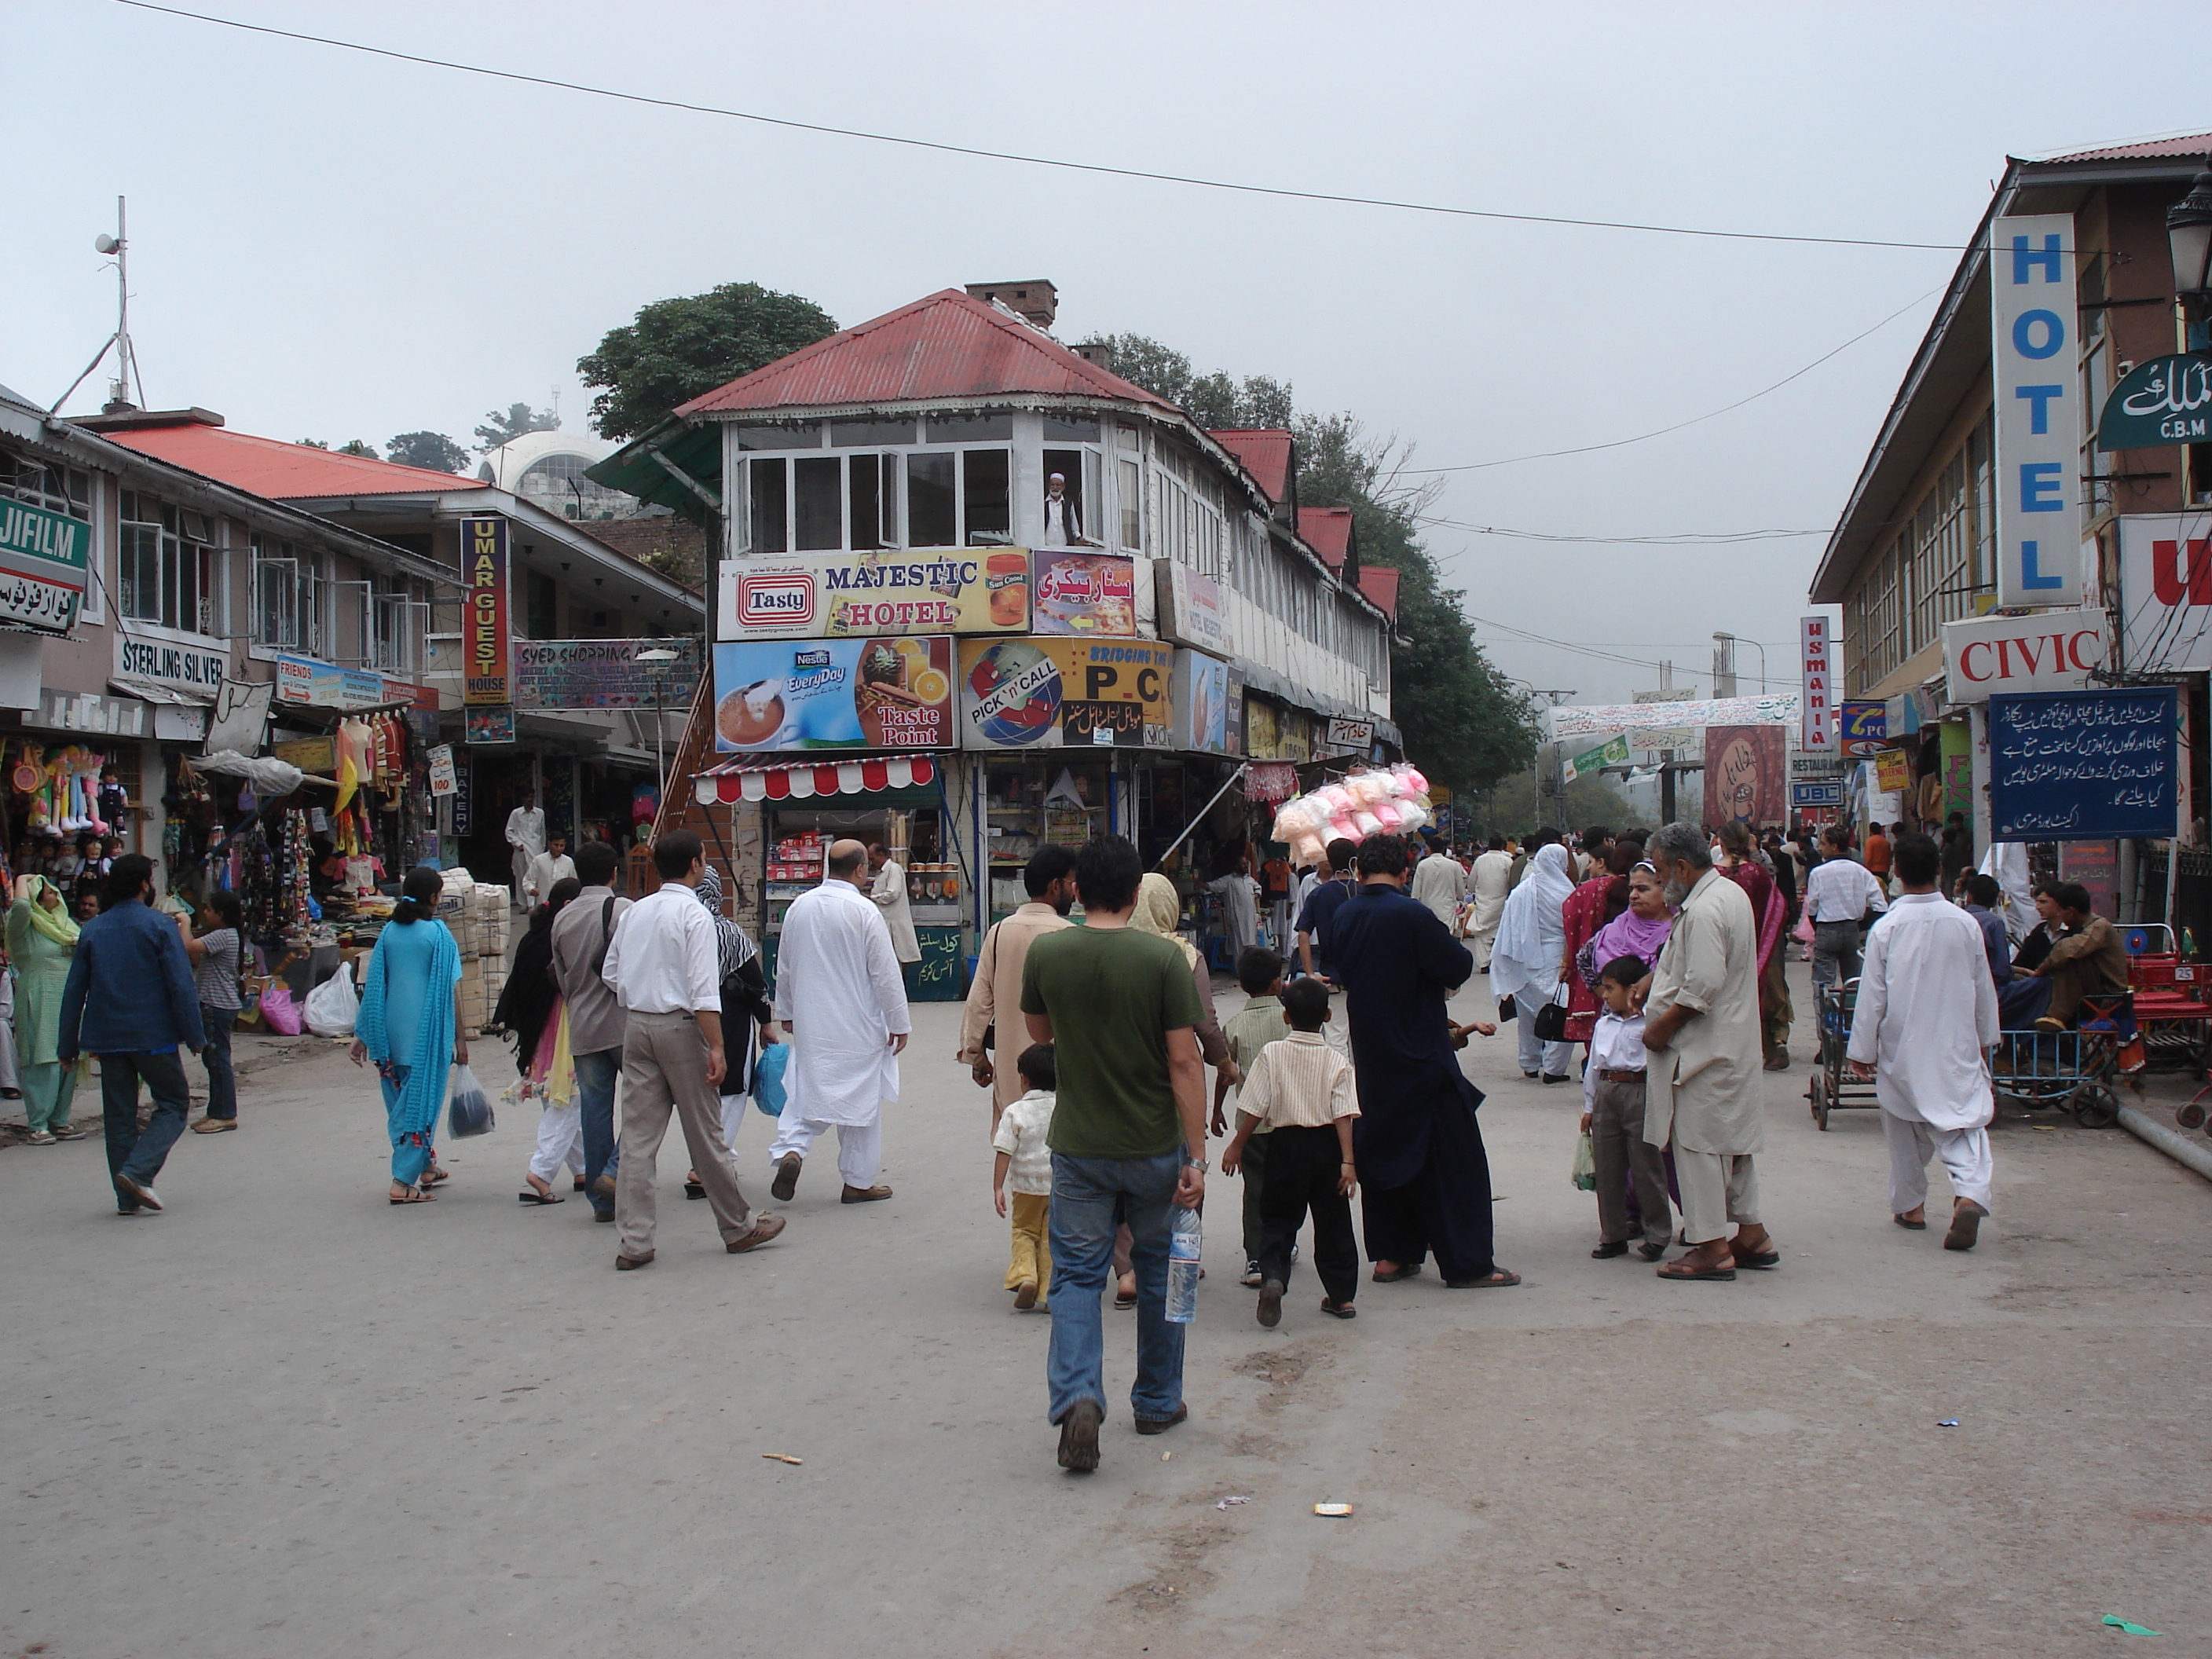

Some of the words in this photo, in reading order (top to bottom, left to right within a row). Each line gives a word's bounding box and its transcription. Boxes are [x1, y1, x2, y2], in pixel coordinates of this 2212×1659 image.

[2012, 233, 2065, 590] HOTEL
[474, 522, 495, 588] UMAR
[826, 561, 979, 589] MAJESTIC
[989, 580, 1004, 589] Sun
[752, 591, 804, 610] Tasty
[849, 601, 954, 626] HOTEL
[475, 593, 496, 676] GUEST
[123, 641, 181, 679] STERLING
[185, 653, 222, 686] SILVER
[522, 648, 555, 664] SYED
[559, 646, 630, 662] SHOPPING
[1090, 646, 1151, 664] BRIDGING
[1960, 629, 2100, 682] CIVIC
[280, 662, 312, 679] FRIENDS
[788, 668, 845, 692] EveryDay
[468, 677, 505, 690] HOUSE
[972, 695, 1004, 723] PICK
[1020, 661, 1057, 690] CALL
[879, 707, 940, 726] Taste
[883, 727, 938, 745] Point
[1877, 765, 1907, 778] INTERNET
[434, 780, 449, 790] 100
[456, 767, 468, 833] BAKERY
[2177, 968, 2192, 980] 25
